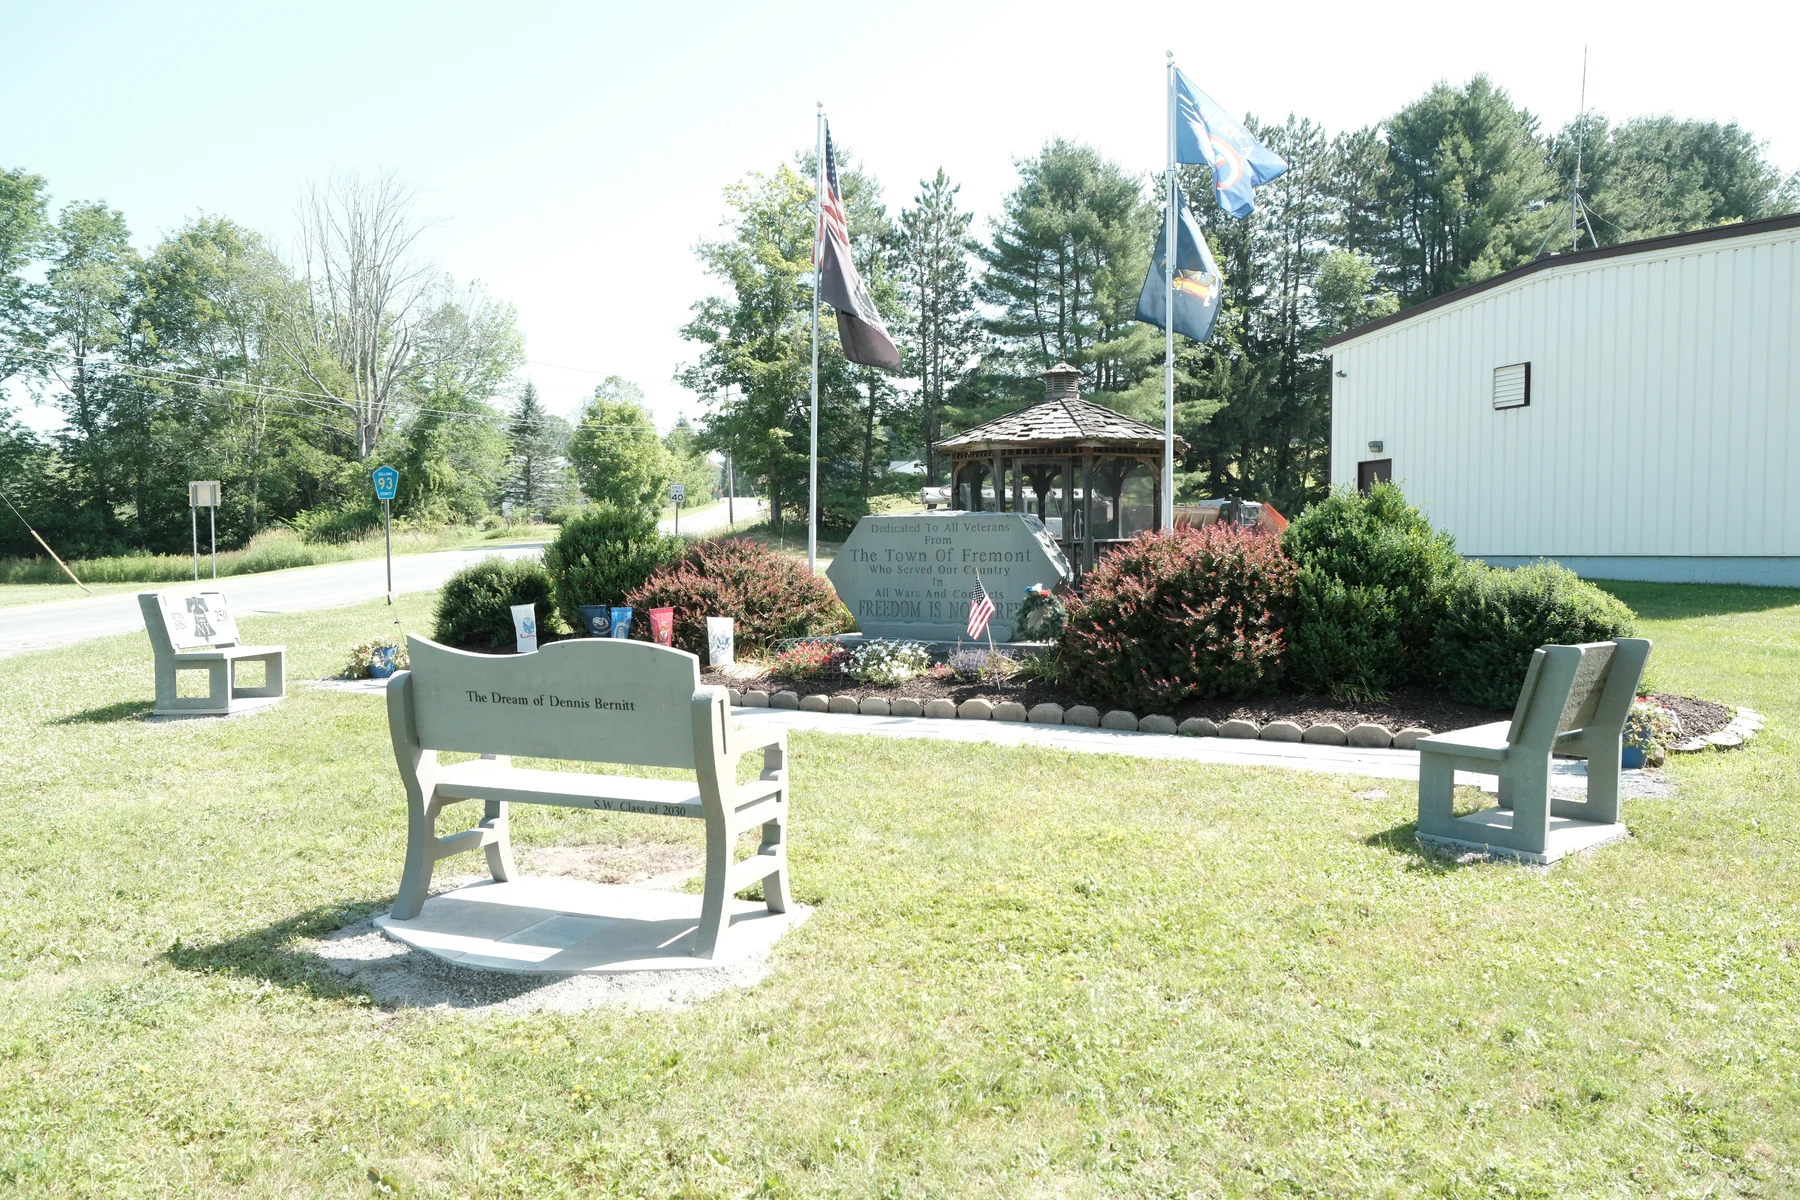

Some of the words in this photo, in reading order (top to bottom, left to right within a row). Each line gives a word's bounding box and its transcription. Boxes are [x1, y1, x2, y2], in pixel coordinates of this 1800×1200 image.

[378, 477, 393, 490] 93
[871, 523, 920, 533] Dedicated
[925, 523, 939, 533] To
[943, 522, 959, 533] All
[963, 522, 1010, 532] Veterans
[924, 535, 952, 545] From
[849, 548, 878, 563] The
[884, 548, 927, 563] Town
[935, 547, 955, 563] Of
[962, 548, 1032, 563] Fremont
[869, 564, 892, 575] Who
[897, 564, 933, 575] Served
[937, 565, 958, 575] Our
[963, 564, 1010, 577] Country
[932, 577, 943, 587] In
[874, 588, 889, 598] All
[894, 588, 920, 599] Wars
[925, 588, 947, 599] And
[214, 610, 228, 622] 250
[858, 599, 921, 618] FREEDOM
[929, 600, 942, 619] IS
[948, 600, 971, 620] NO
[466, 690, 487, 703] The
[491, 692, 528, 705] Dream
[533, 694, 545, 706] of
[549, 695, 590, 709] Dennis
[594, 697, 636, 711] Bernitt
[594, 799, 616, 811] S.W.
[620, 801, 645, 813] Class
[648, 804, 660, 815] of
[662, 805, 686, 817] 2030
